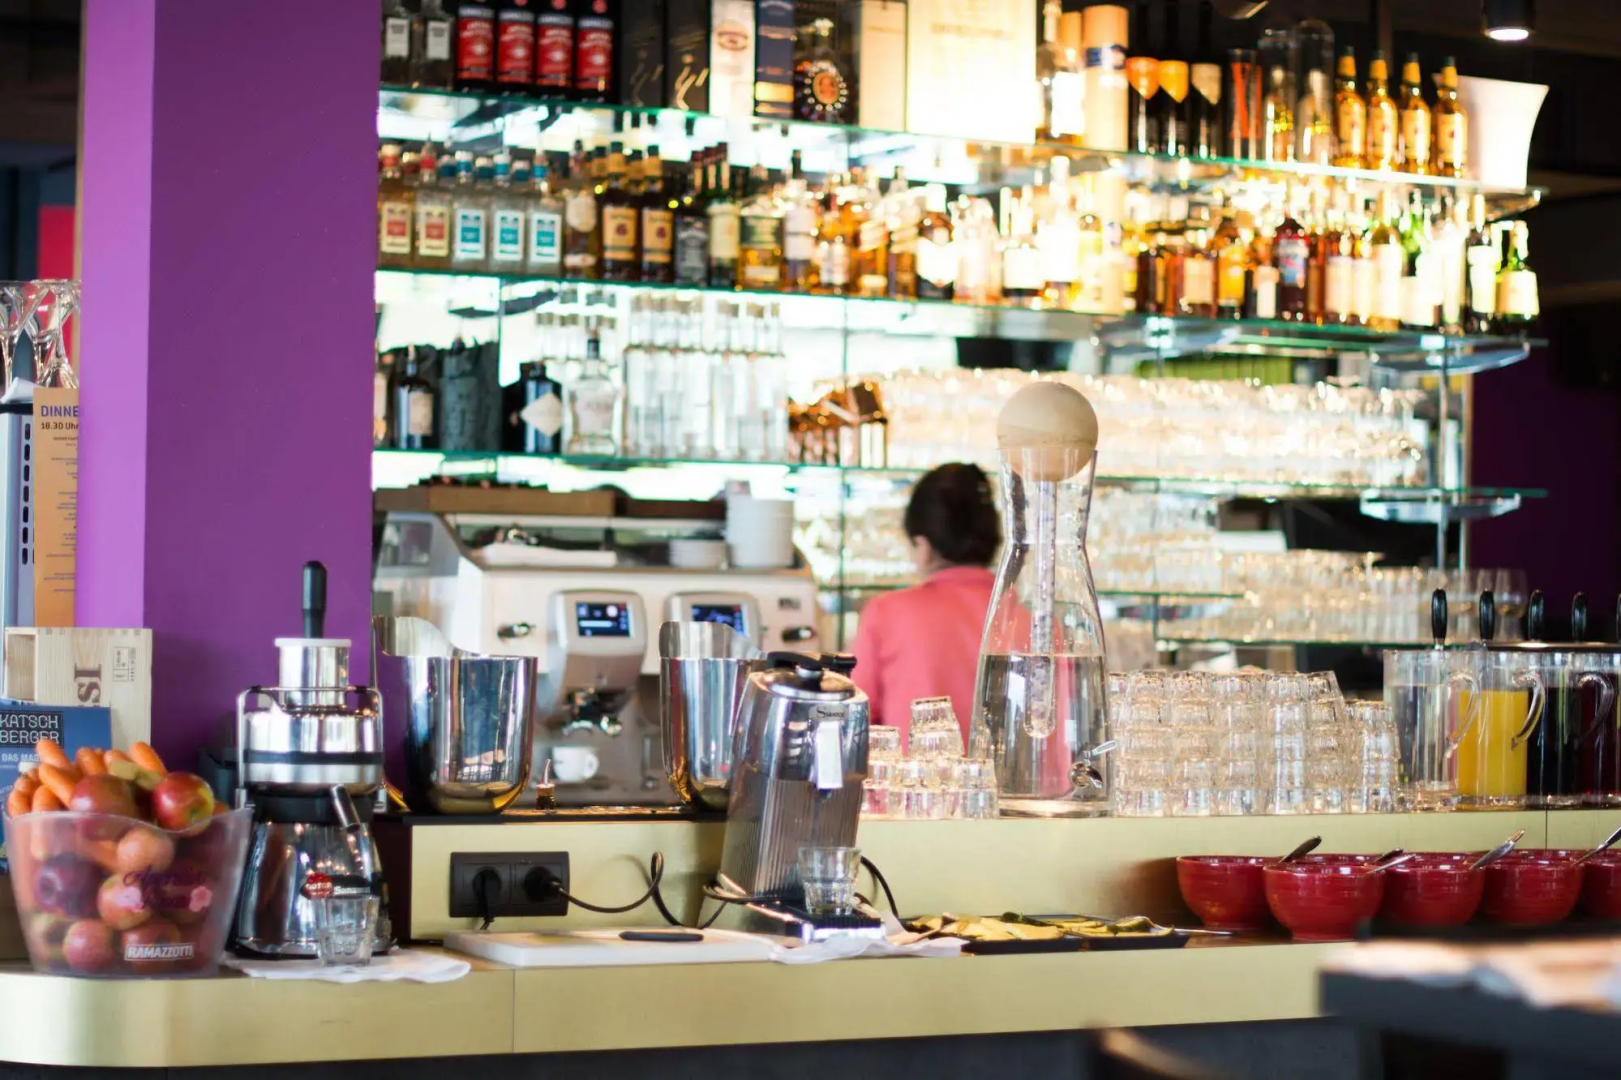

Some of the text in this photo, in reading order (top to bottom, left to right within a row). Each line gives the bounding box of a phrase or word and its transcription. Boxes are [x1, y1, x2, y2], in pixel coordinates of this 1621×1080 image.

[41, 422, 63, 430] 18.30
[0, 714, 59, 729] KATSCH
[0, 730, 60, 744] BERGER
[2, 753, 42, 762] DAS MAG
[127, 945, 194, 959] RAMAZZOTTI
